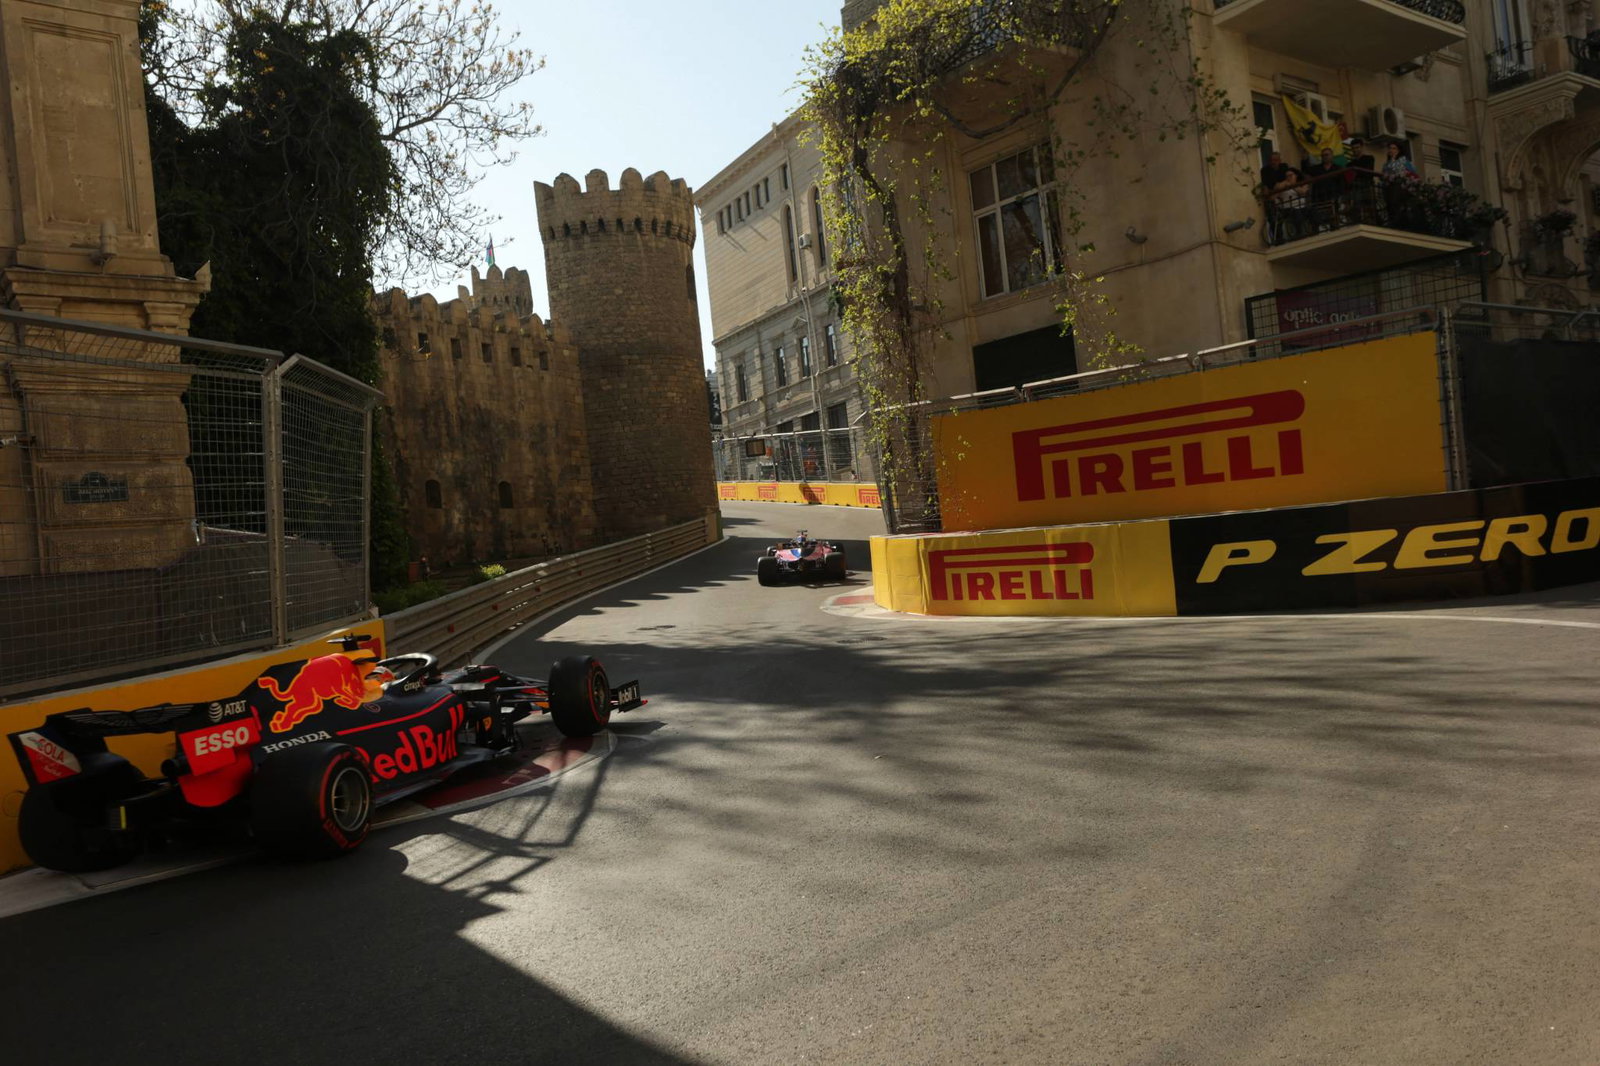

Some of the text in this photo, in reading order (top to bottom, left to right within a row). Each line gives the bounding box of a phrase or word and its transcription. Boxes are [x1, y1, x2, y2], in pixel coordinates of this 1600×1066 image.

[1012, 389, 1306, 502] PIRELLI
[758, 485, 778, 499] PIRELLI
[802, 487, 826, 502] PIRELLI
[858, 488, 881, 504] PIREL
[1196, 507, 1600, 583] P ZERO
[928, 542, 1095, 601] PIRELLI
[224, 700, 247, 716] AT&T
[194, 726, 250, 756] ESSO
[262, 730, 332, 754] HONDA
[409, 704, 465, 769] Bull
